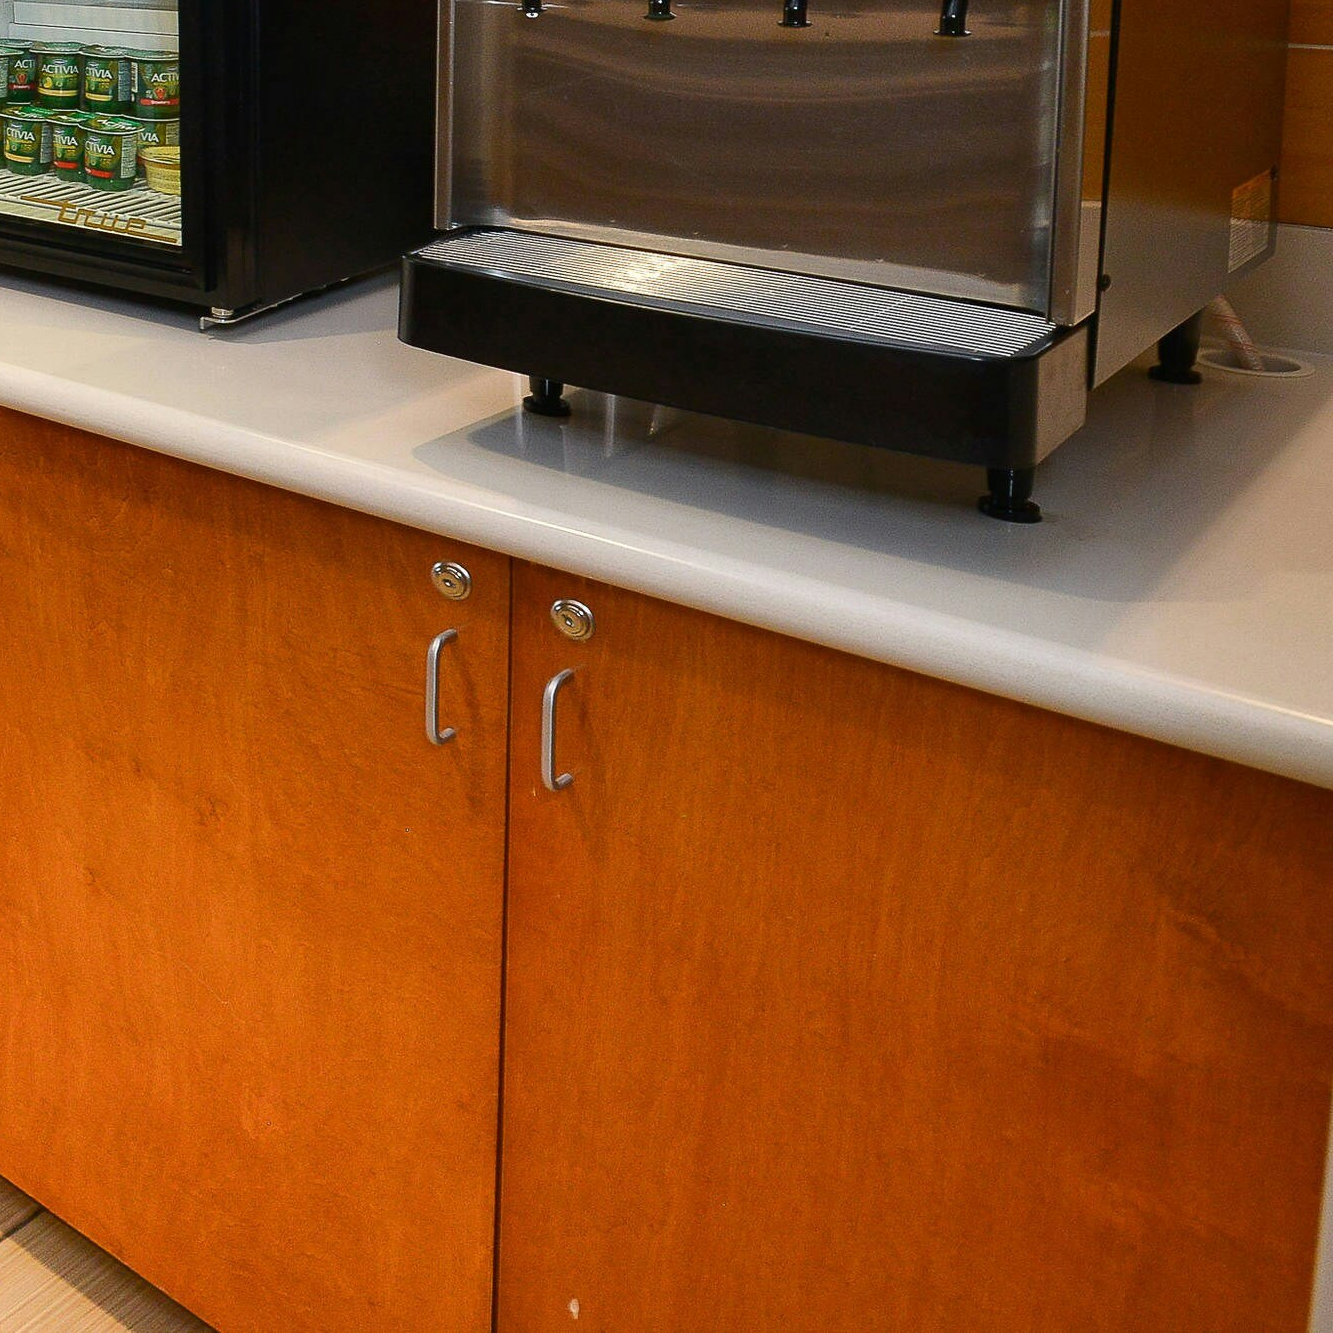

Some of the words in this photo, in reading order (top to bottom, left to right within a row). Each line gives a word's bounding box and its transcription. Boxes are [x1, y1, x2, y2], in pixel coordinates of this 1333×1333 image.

[41, 64, 79, 74] ACTIVIA
[85, 66, 113, 79] CTIVIA
[6, 127, 36, 141] CTIVIA
[53, 134, 79, 146] TIVIA
[84, 140, 116, 156] CTIVIA
